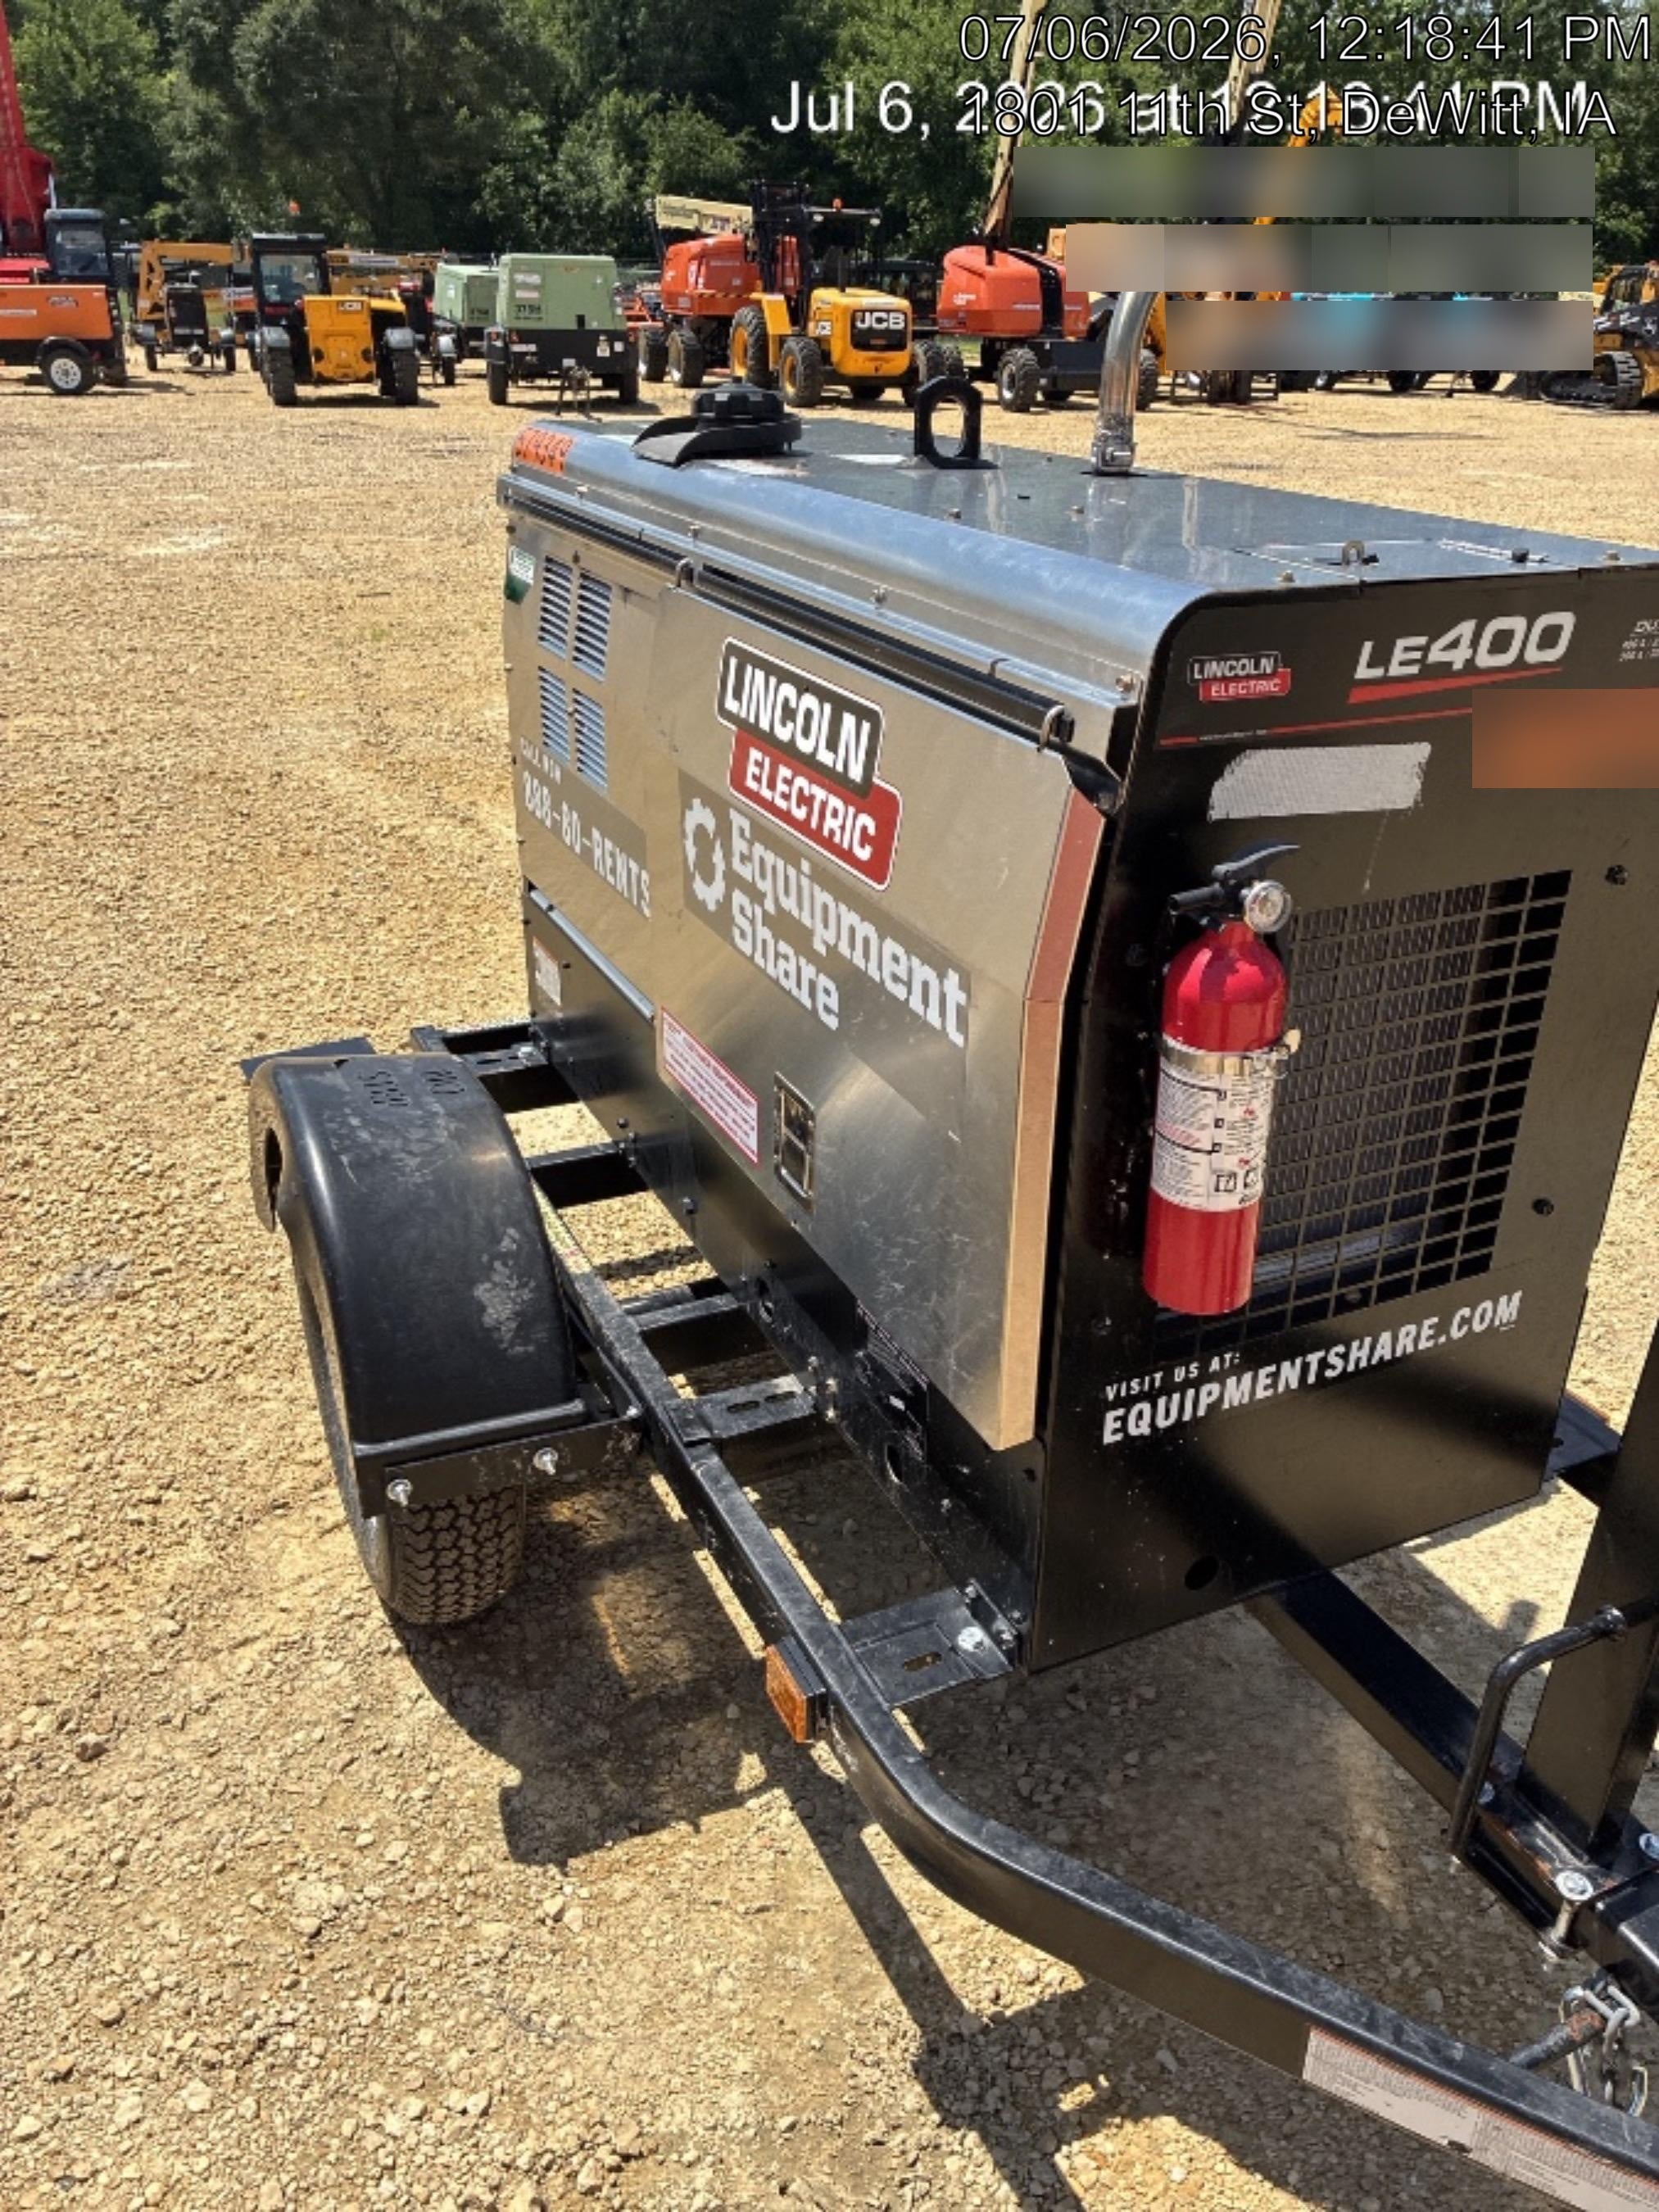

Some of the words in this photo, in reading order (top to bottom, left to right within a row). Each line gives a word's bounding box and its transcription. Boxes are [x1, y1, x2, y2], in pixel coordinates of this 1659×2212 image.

[854, 311, 905, 329] JCB
[1193, 657, 1275, 679] LINCOLN
[1211, 678, 1281, 697] ELECTRIC
[1353, 611, 1576, 679] LE400
[723, 655, 871, 784] LINCOLN
[745, 746, 877, 862] ELECTRIC
[729, 807, 968, 1049] Equipment
[732, 888, 841, 1031] Share
[1103, 1290, 1523, 1446] EQUIPMENTSHARE.COM
[1104, 1370, 1163, 1403] VISIT
[1173, 1362, 1199, 1383] US
[1208, 1352, 1241, 1375] AT:
